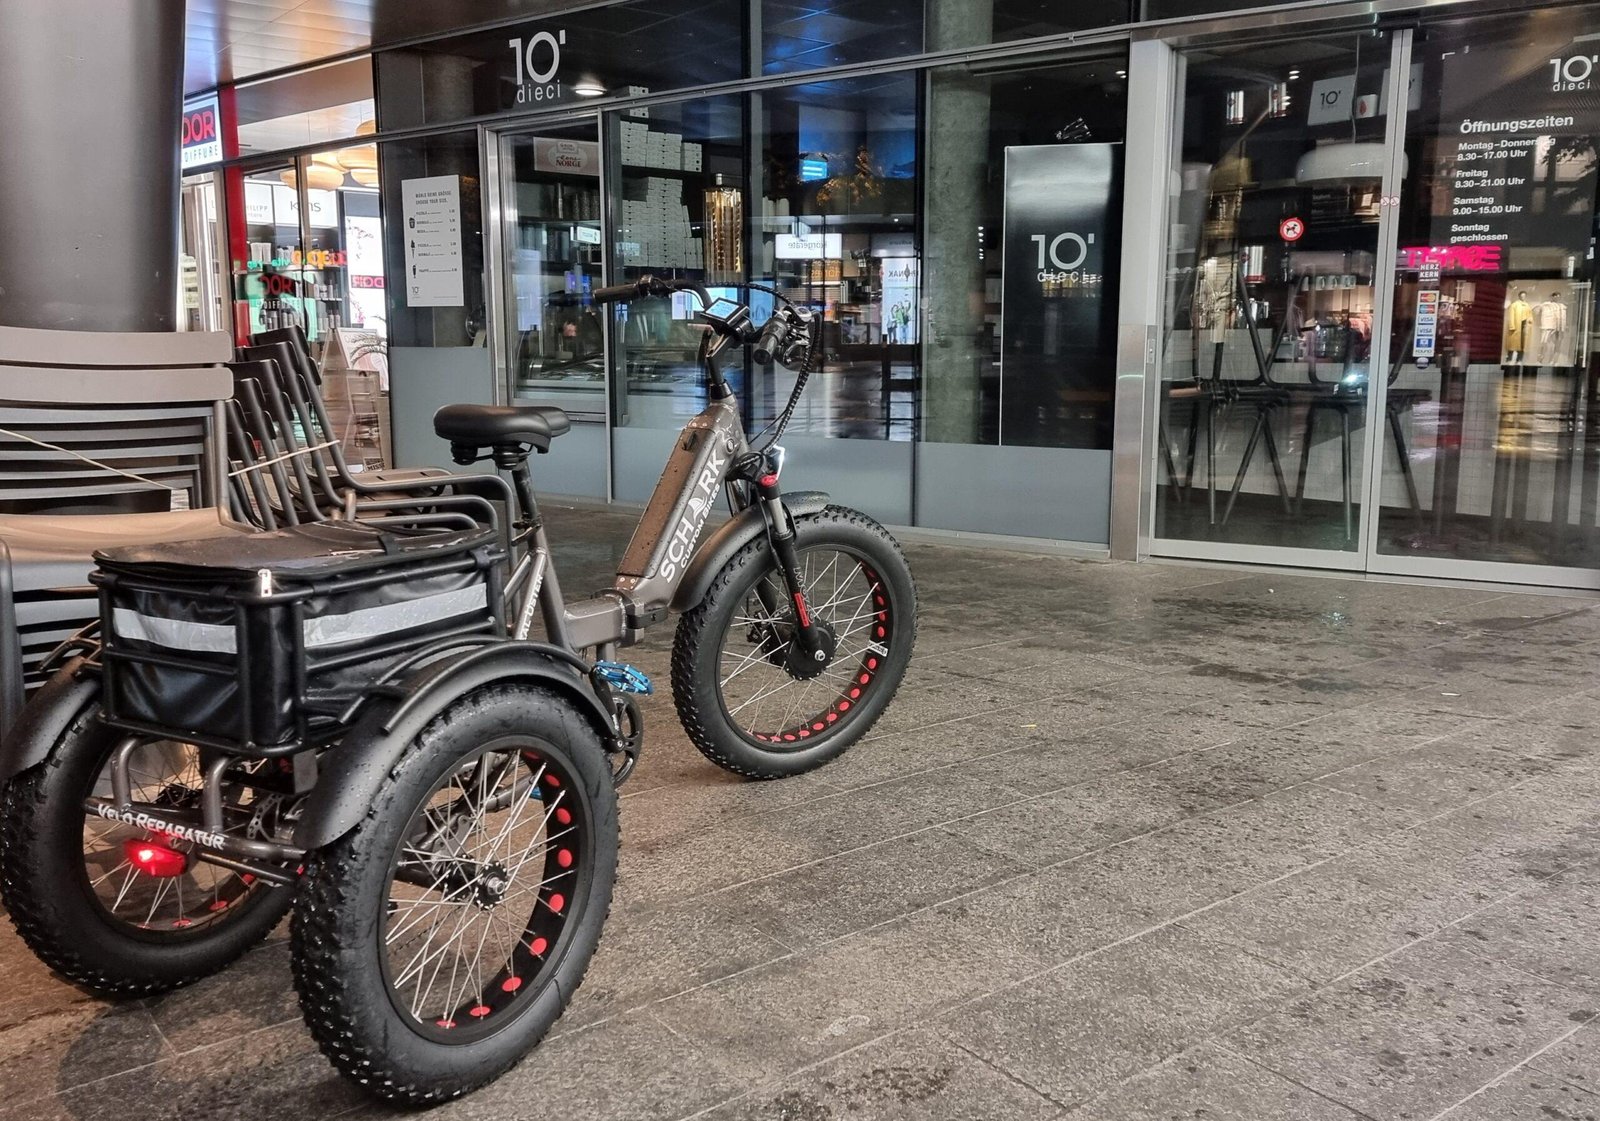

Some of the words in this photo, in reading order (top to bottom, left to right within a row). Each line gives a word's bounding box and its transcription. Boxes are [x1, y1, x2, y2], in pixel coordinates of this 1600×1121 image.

[1552, 79, 1591, 92] dieci
[517, 79, 561, 104] dieci
[1460, 116, 1574, 134] Öffnungszeiten
[1510, 149, 1528, 158] Uhr
[1456, 169, 1488, 178] Freitag
[1507, 177, 1525, 185] Uhr
[1453, 197, 1494, 205] Samstag
[1505, 204, 1523, 213] Uhr
[1451, 224, 1490, 232] Sonntag
[1450, 234, 1508, 243] geschlossen
[680, 518, 705, 569] CUSTOM
[703, 484, 720, 519] BIKES
